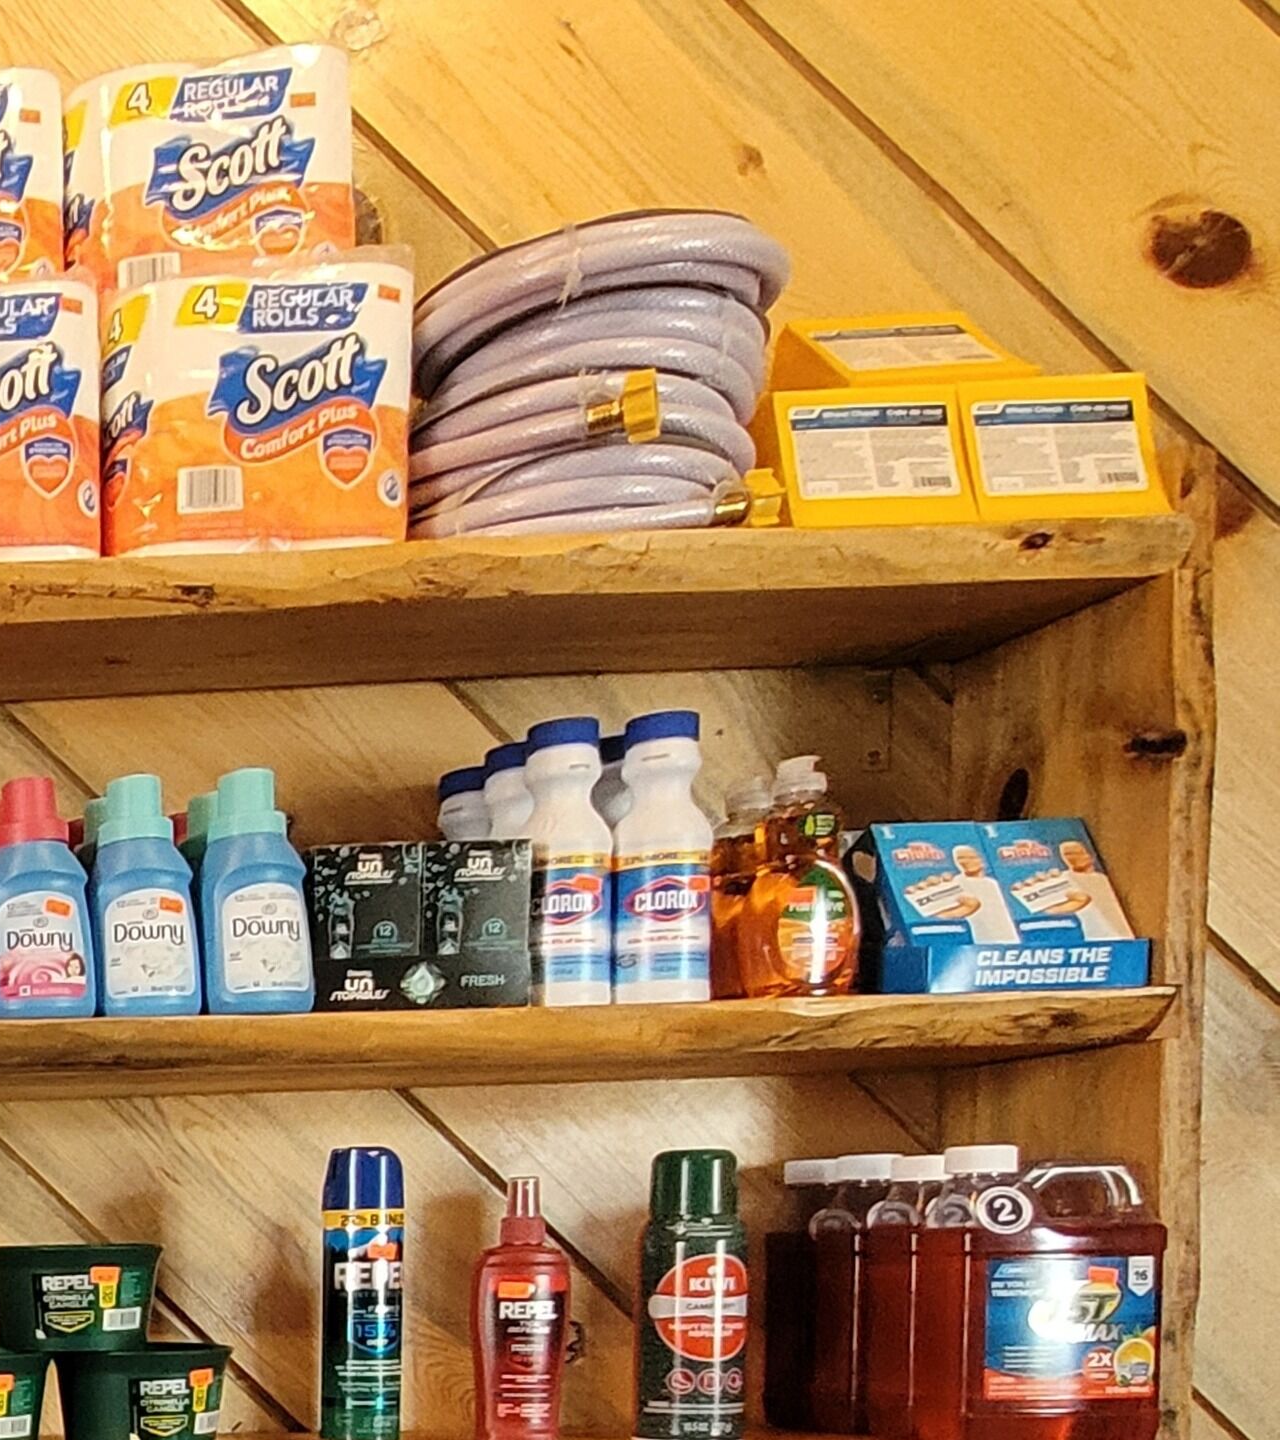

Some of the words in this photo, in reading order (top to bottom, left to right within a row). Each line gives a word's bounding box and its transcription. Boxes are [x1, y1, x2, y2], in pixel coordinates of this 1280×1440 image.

[127, 82, 151, 112] 4
[183, 75, 279, 101] REGULAR
[171, 115, 289, 212] Scott
[193, 286, 219, 319] 4
[252, 287, 354, 310] REGULAR
[252, 307, 320, 328] ROLLS
[236, 333, 361, 425] Scott
[19, 412, 57, 440] Plus
[240, 421, 316, 459] Comfort
[634, 891, 699, 911] CLOROX
[113, 923, 185, 946] Downy
[232, 917, 301, 941] Downy
[378, 926, 393, 937] 12
[487, 922, 501, 934] 12
[6, 929, 73, 952] Downy
[977, 948, 1065, 966] CLEANS
[1069, 946, 1112, 964] THE
[460, 974, 506, 988] FRESH
[974, 965, 1111, 987] IMPOSSIBLE
[992, 1197, 1017, 1222] 2
[41, 1275, 94, 1291] REPEL
[1087, 1352, 1112, 1368] 2X
[139, 1379, 190, 1395] REPEL
